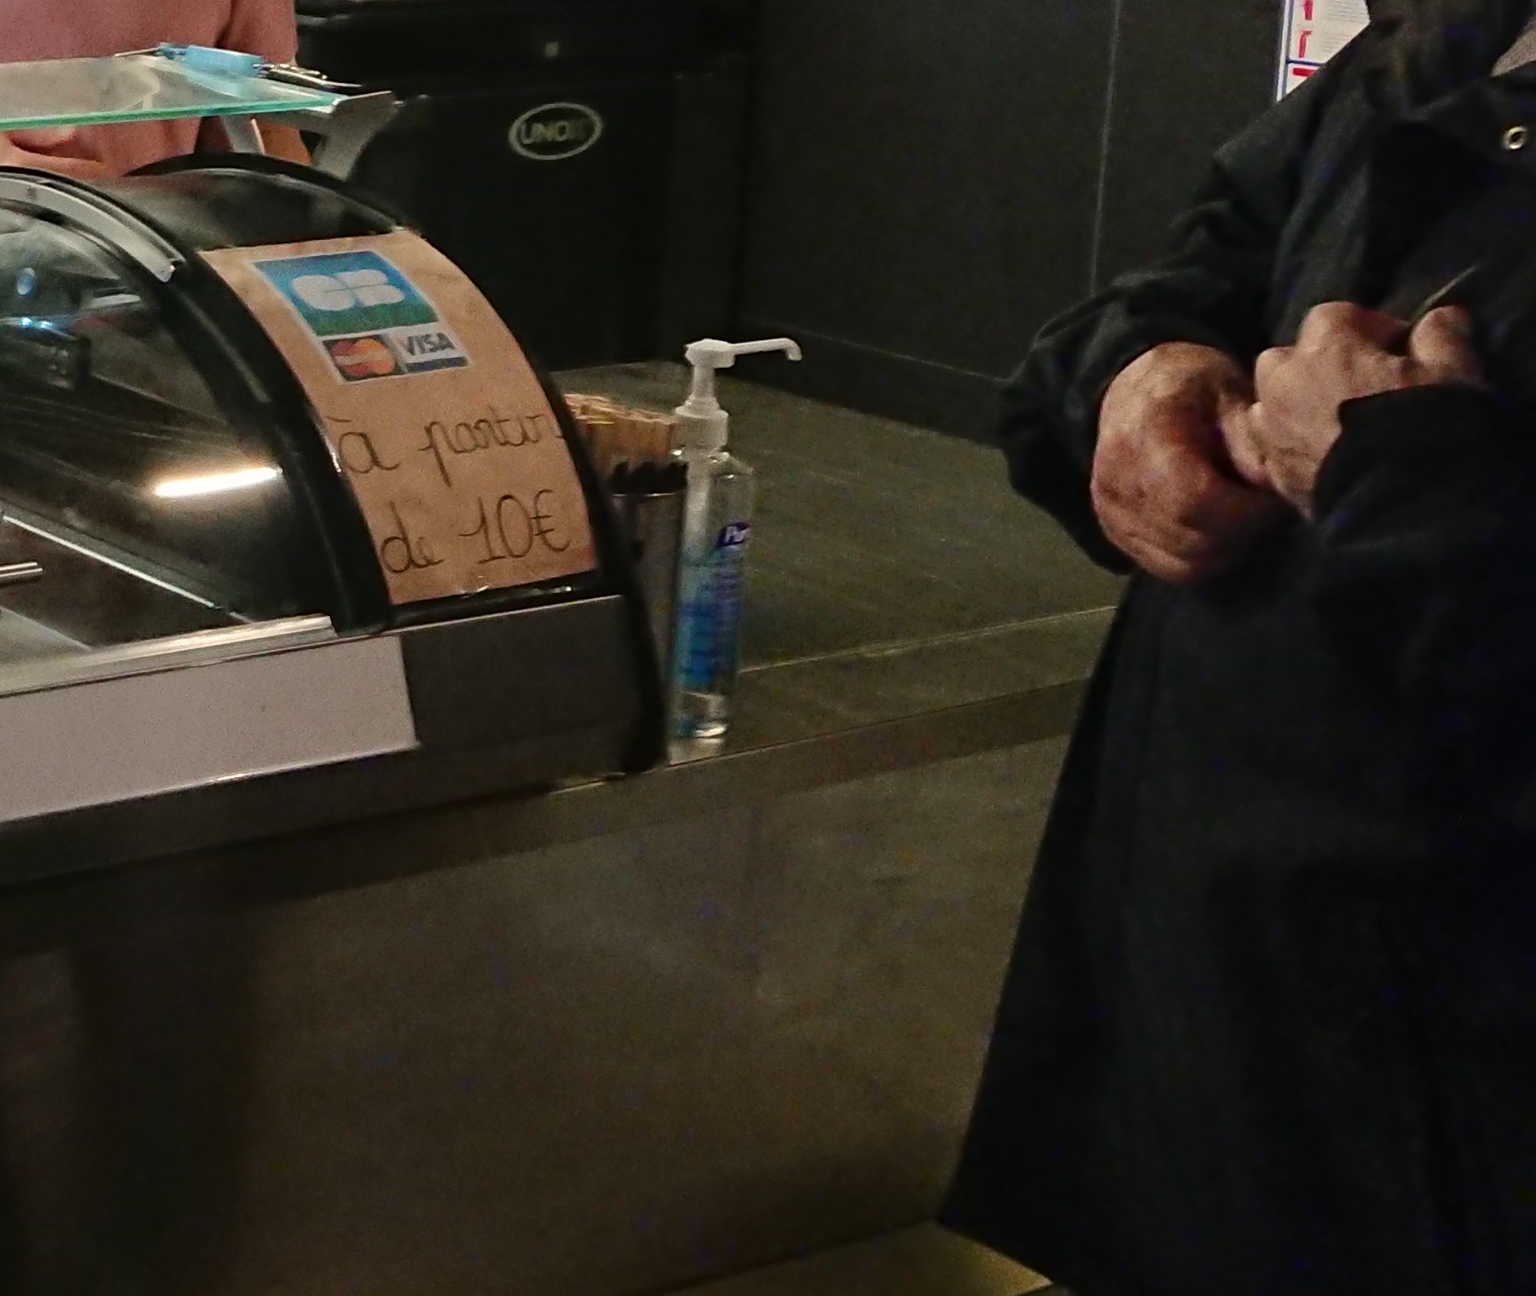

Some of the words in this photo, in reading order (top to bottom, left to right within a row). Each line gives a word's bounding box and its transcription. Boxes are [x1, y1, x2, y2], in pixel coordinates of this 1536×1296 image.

[397, 331, 457, 357] VISA
[419, 406, 564, 487] partir
[458, 489, 571, 564] 10€
